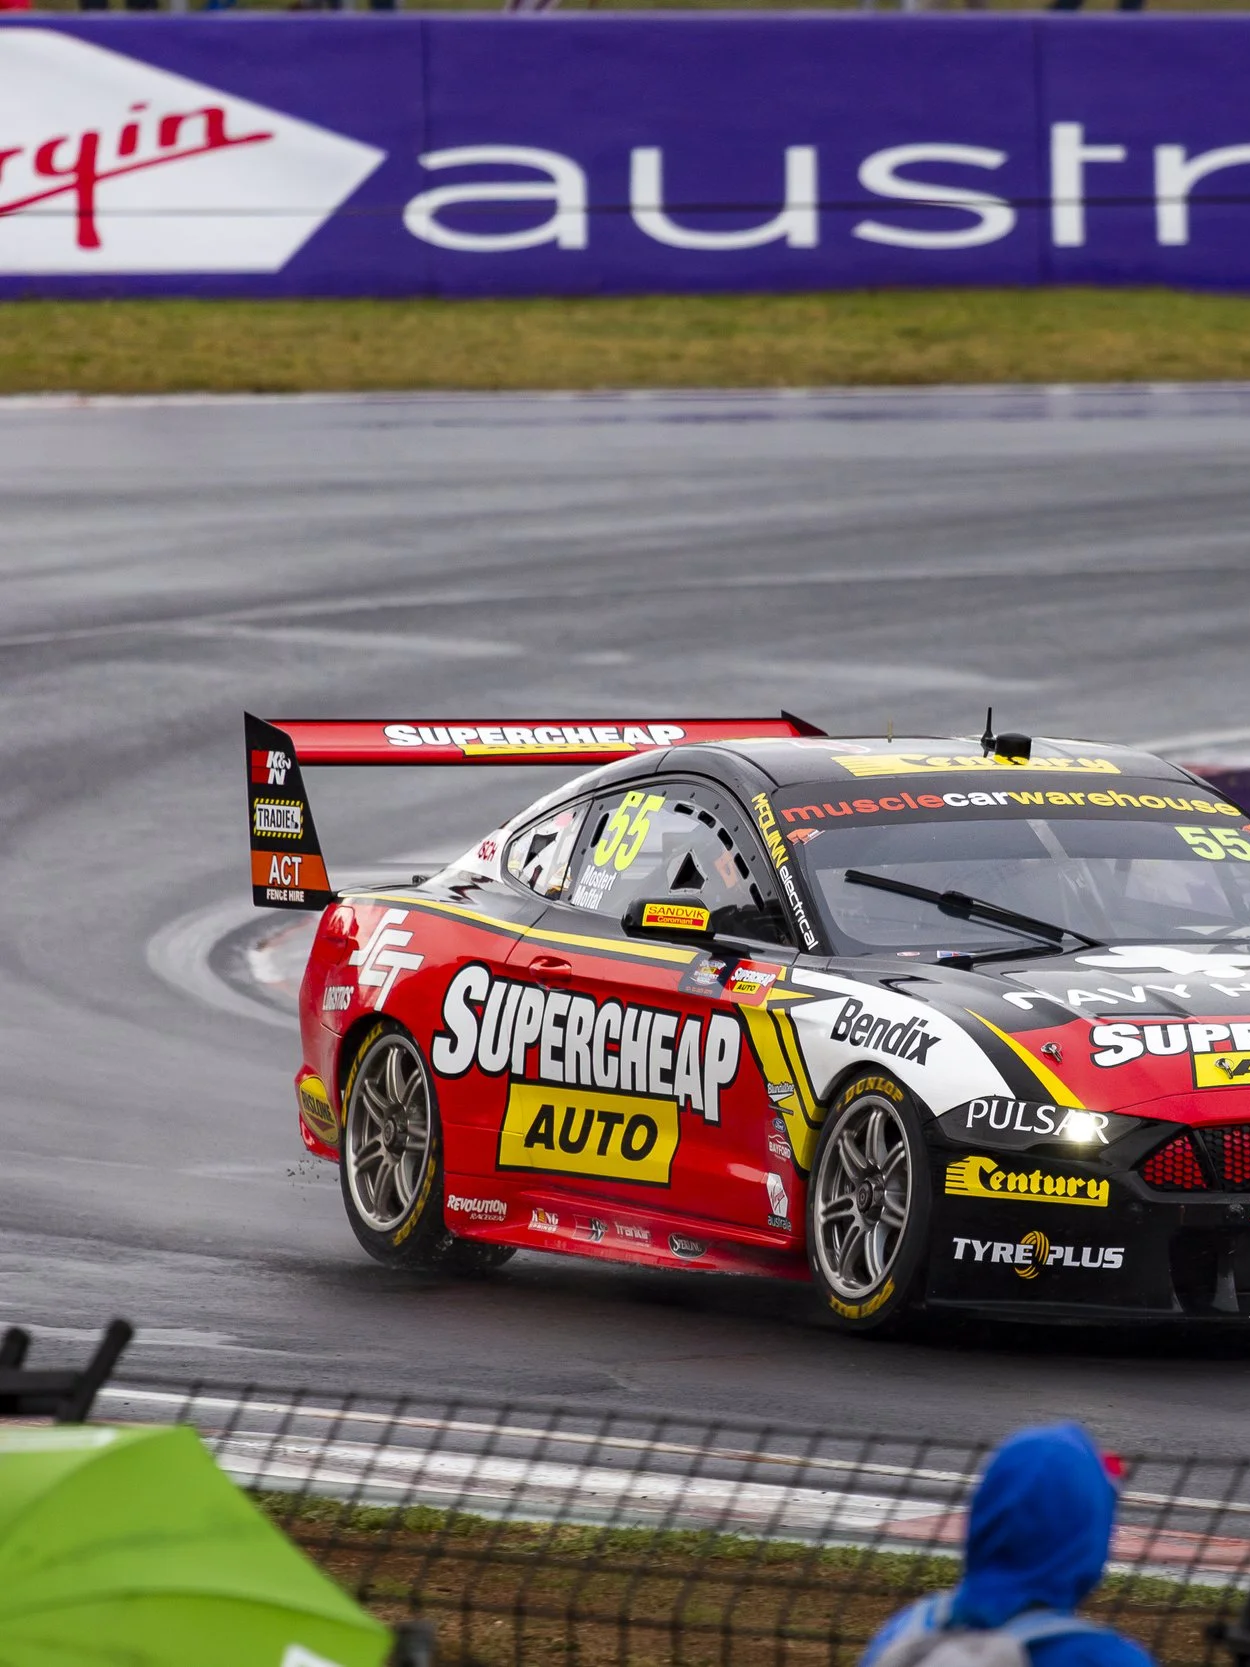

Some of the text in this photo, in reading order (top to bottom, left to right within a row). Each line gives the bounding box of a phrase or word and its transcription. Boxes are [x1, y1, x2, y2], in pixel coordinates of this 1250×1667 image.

[384, 724, 684, 746] SUPERCHEAP
[258, 807, 290, 829] TRADIE
[780, 788, 1241, 823] musclecarwarehouse
[594, 791, 666, 871] 55
[269, 855, 302, 886] ACT
[266, 888, 305, 903] FENCE HIRE
[779, 865, 819, 950] electrical
[648, 906, 704, 919] SANDVIK
[657, 916, 693, 925] Coromant
[1002, 984, 1192, 1010] NAVY
[432, 964, 741, 1122] SUPERCHEAP
[830, 997, 942, 1067] Bendix
[844, 1076, 904, 1105] DUNLOP
[523, 1104, 659, 1162] AUTO
[966, 1099, 1110, 1145] PULSAR
[945, 1156, 1110, 1207] Century
[447, 1195, 507, 1215] REVOLUTION
